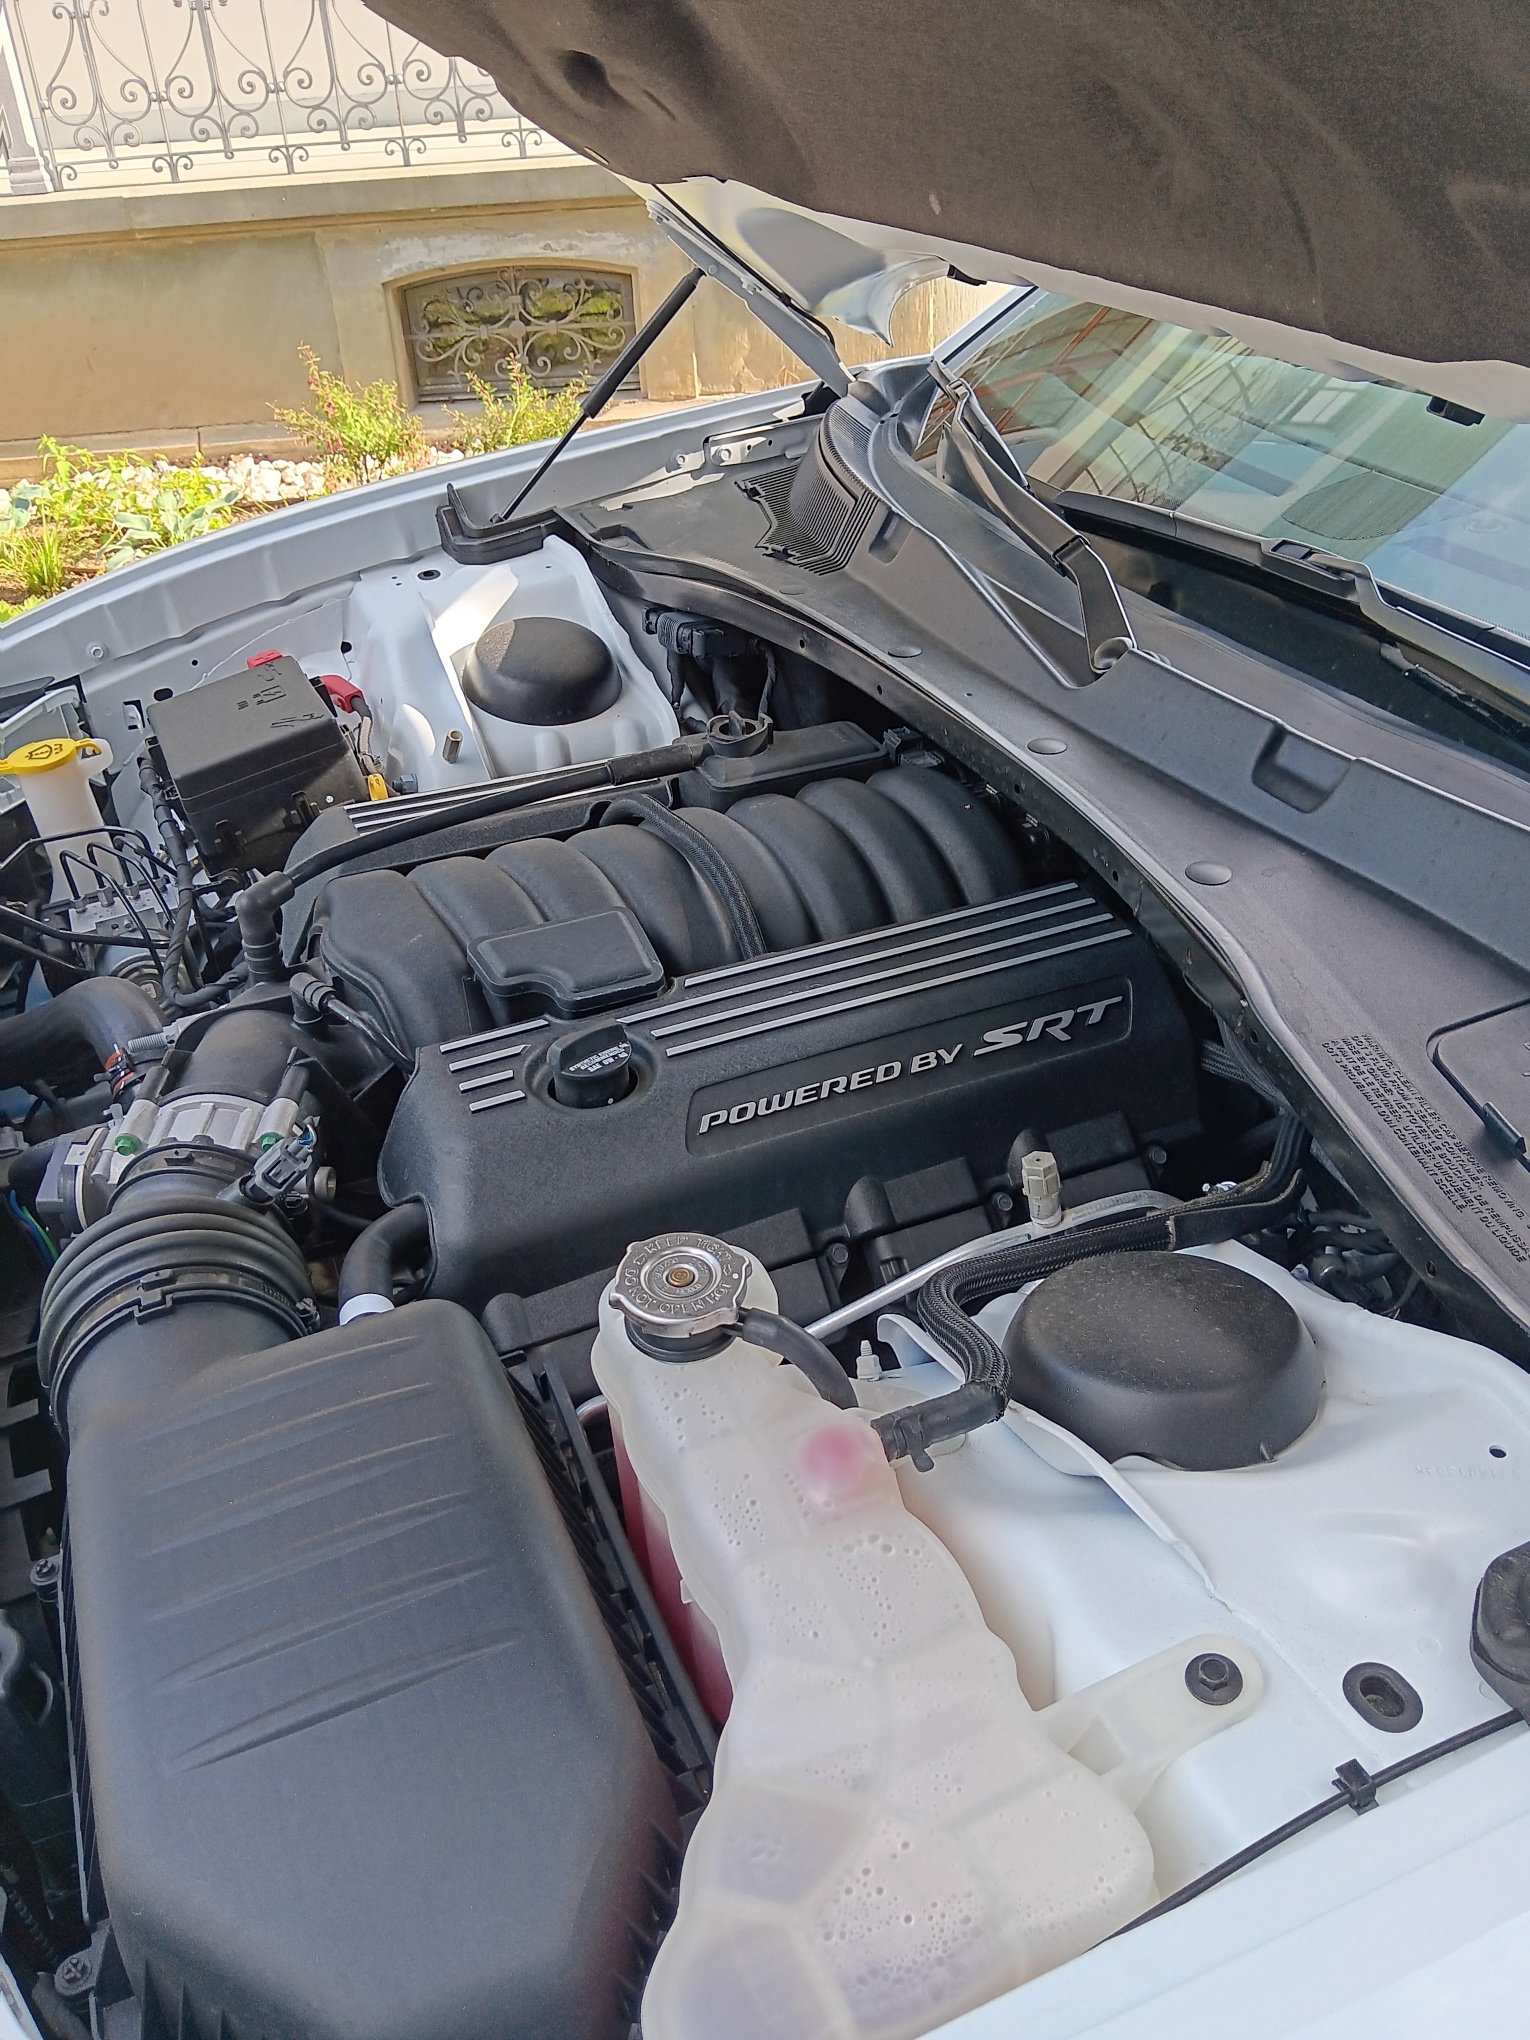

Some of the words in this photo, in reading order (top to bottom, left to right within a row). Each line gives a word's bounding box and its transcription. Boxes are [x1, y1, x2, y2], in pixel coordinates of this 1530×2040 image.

[698, 1061, 901, 1134] POWERED
[909, 1043, 964, 1074] BY
[973, 996, 1124, 1056] SRT
[1321, 1042, 1340, 1057] DOT
[1393, 1128, 1439, 1177] CONTENANT
[1350, 1035, 1369, 1050] DOT
[1369, 1057, 1391, 1079] FLUID
[1387, 1079, 1412, 1102] FROM
[1413, 1109, 1444, 1140] SEALED
[1356, 1055, 1371, 1067] EN
[1392, 1099, 1432, 1140] NETTOYER
[1427, 1140, 1443, 1152] LE
[1437, 1152, 1478, 1194] BOUCHON
[1473, 1194, 1490, 1207] DE
[1392, 1070, 1417, 1096] CLEAN
[1414, 1096, 1442, 1123] FILLER
[1438, 1123, 1457, 1140] CAP
[1453, 1141, 1487, 1175] BEFORE
[1330, 1040, 1357, 1064] AVANT
[1352, 1065, 1367, 1077] DE
[1362, 1076, 1376, 1087] LE
[1402, 1125, 1437, 1161] UTILISER
[1479, 1215, 1496, 1229] DU
[1491, 1229, 1528, 1263] LIQUIDE
